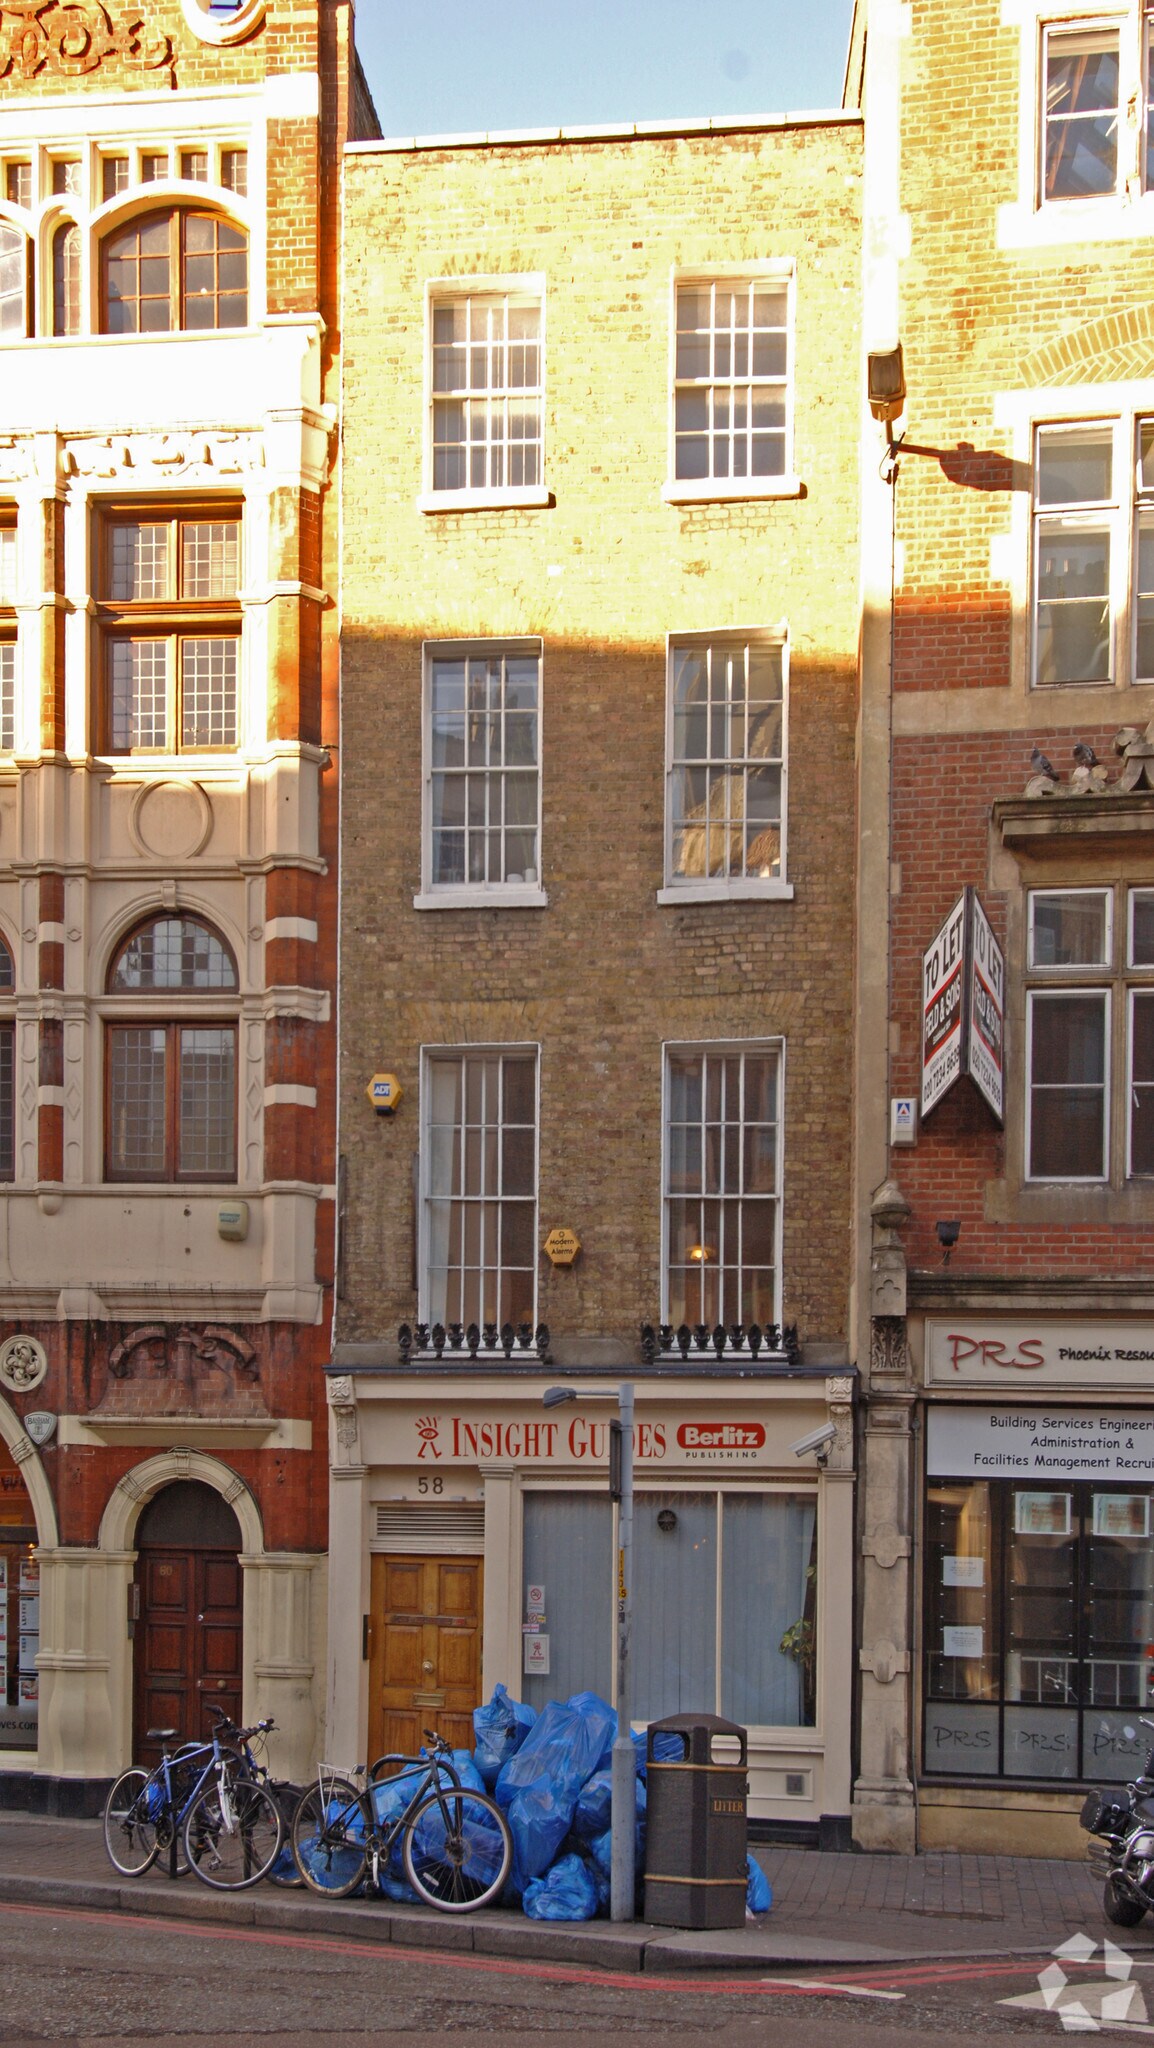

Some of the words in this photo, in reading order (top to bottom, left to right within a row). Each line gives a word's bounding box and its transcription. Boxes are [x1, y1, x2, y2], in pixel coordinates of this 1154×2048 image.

[926, 949, 939, 998] TO
[943, 911, 963, 977] LET
[975, 907, 986, 963] TO
[988, 936, 1002, 997] LET
[374, 1085, 390, 1095] ADT
[947, 1334, 1045, 1371] PRS
[1058, 1345, 1111, 1361] Phoenix
[990, 1415, 1037, 1431] Building
[1041, 1417, 1094, 1430] Services
[451, 1417, 558, 1458] INSIGHT
[568, 1417, 667, 1459] GUES
[685, 1426, 758, 1446] Berlitz
[1030, 1436, 1120, 1449] Administration
[1125, 1438, 1134, 1449] &
[974, 1453, 1029, 1466] Facilities
[1034, 1454, 1111, 1471] Management
[417, 1476, 444, 1495] 58
[159, 1565, 173, 1576] 60
[933, 1726, 992, 1748] PRS
[714, 1801, 744, 1812] LITTER
